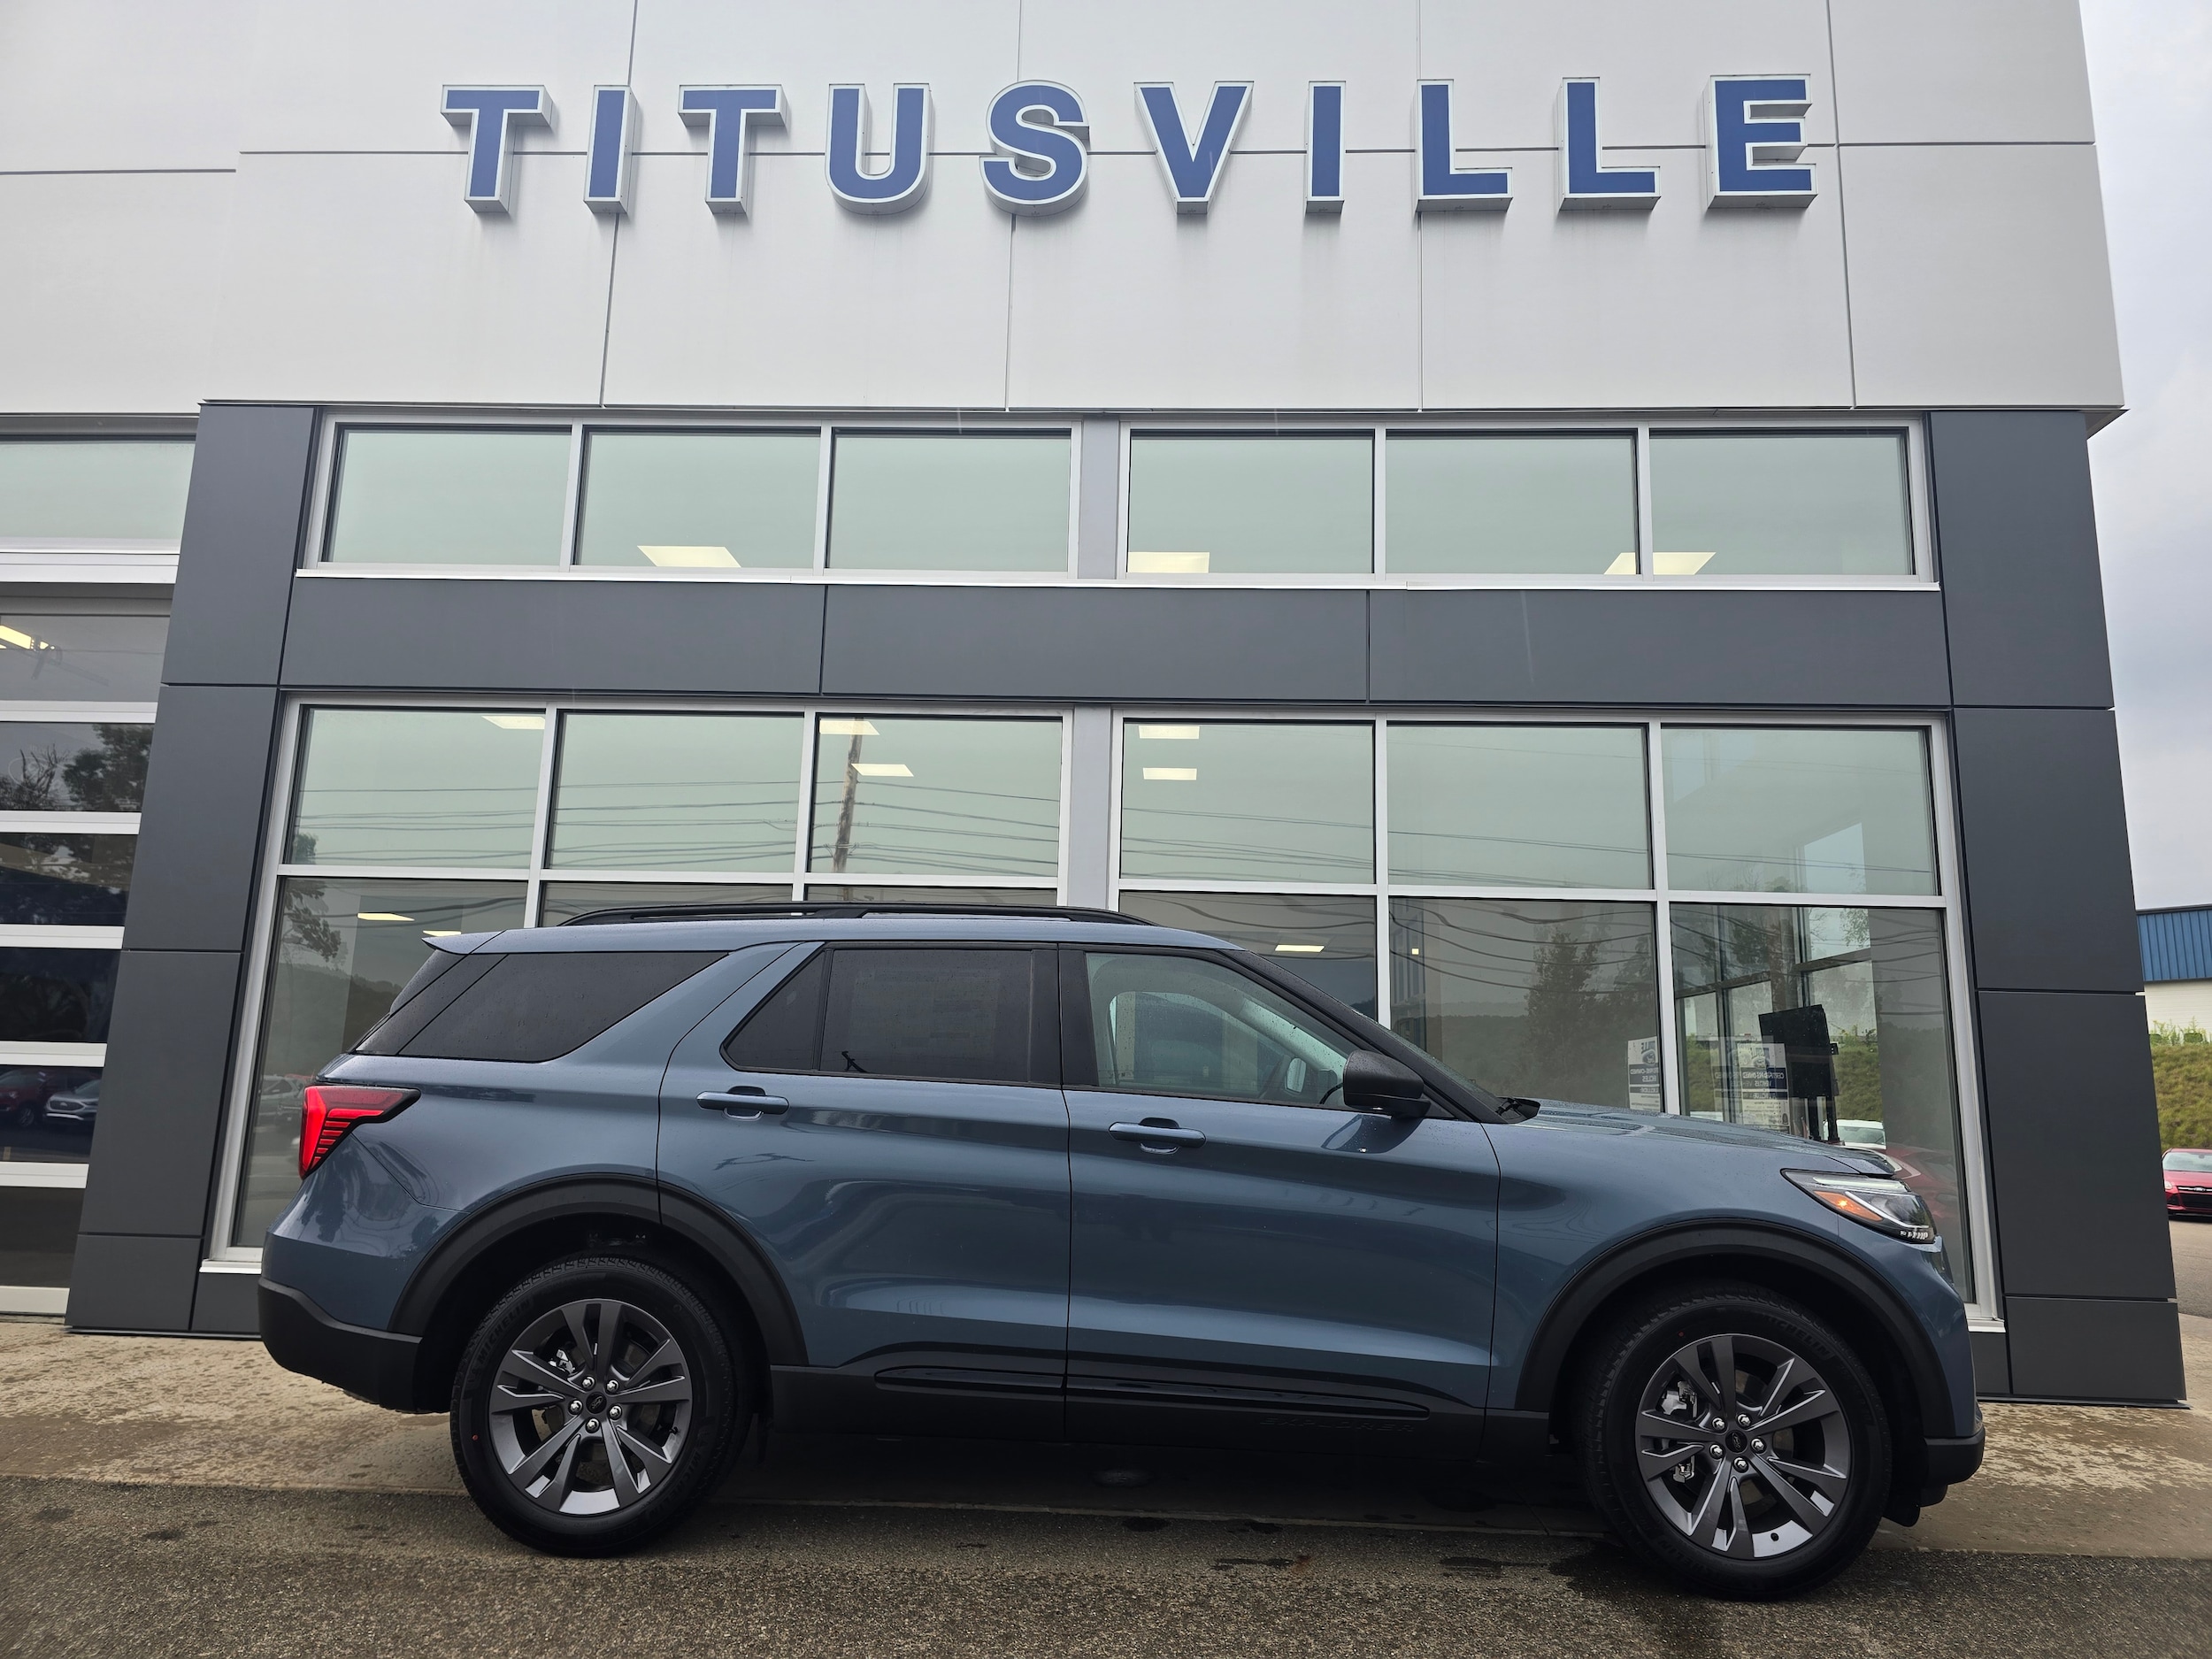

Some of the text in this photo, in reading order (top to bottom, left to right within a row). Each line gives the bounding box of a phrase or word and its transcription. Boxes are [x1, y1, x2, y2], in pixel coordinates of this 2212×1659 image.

[441, 75, 1818, 215] TITUSVILLE
[477, 1298, 531, 1363] MICHELIN
[1259, 1417, 1415, 1432] EXPLORER
